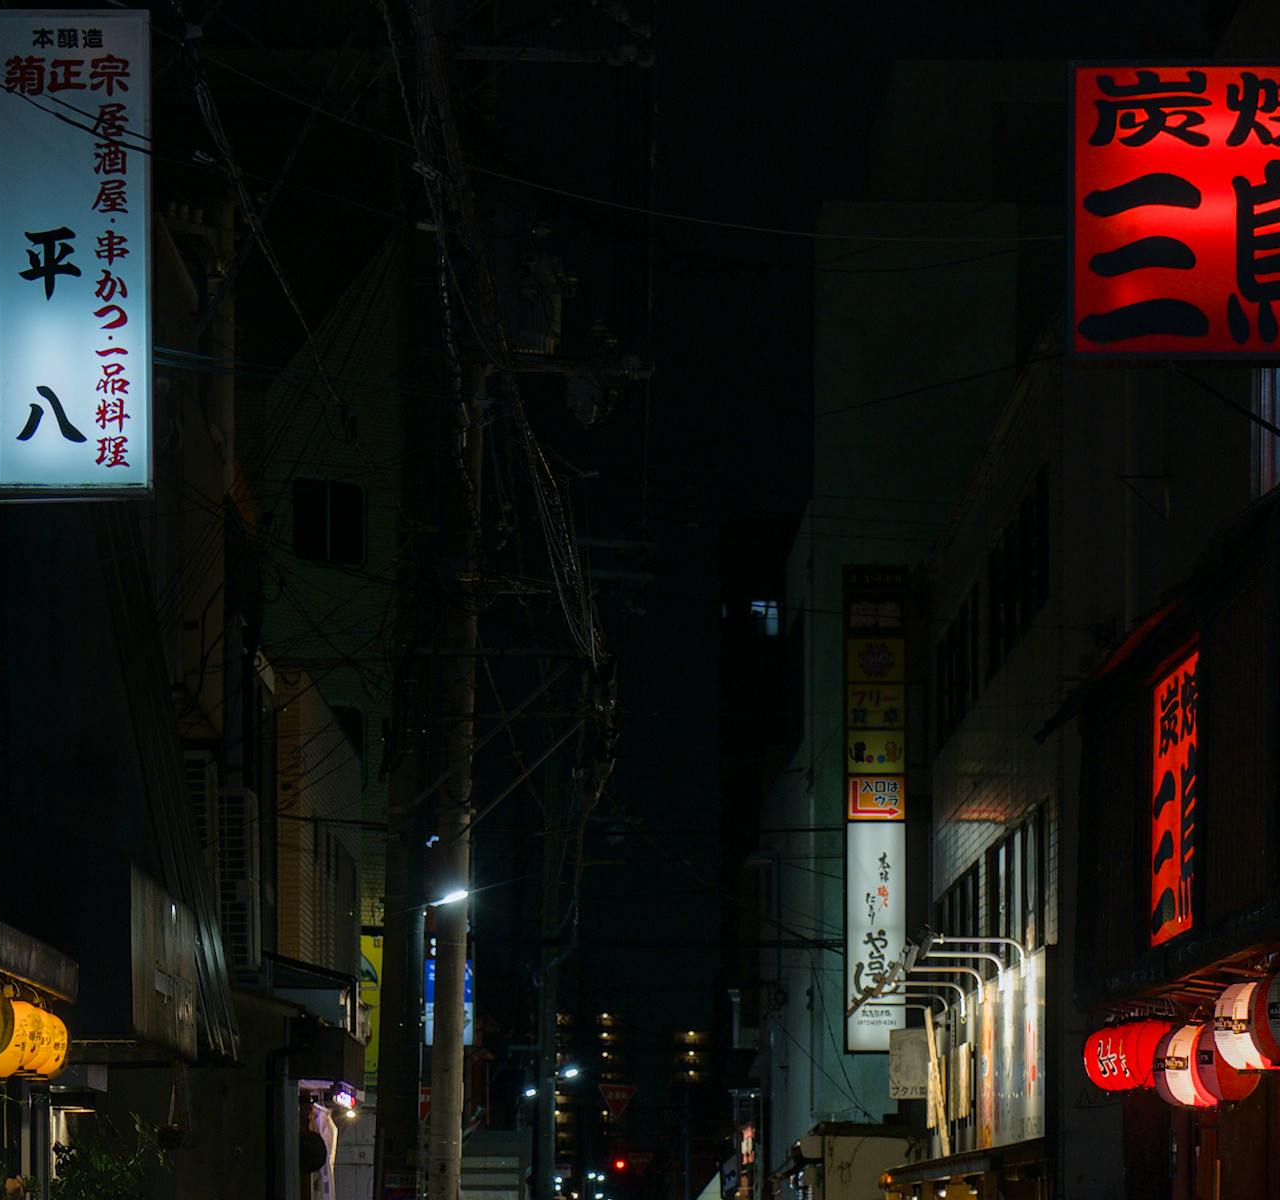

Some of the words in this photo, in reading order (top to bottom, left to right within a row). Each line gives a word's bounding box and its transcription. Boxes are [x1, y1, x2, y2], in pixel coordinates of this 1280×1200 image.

[33, 29, 103, 48] 本醸造
[4, 54, 130, 96] 菊正宗
[16, 227, 87, 443] 平八
[862, 781, 898, 793] 入口は
[874, 794, 898, 807] ウラ
